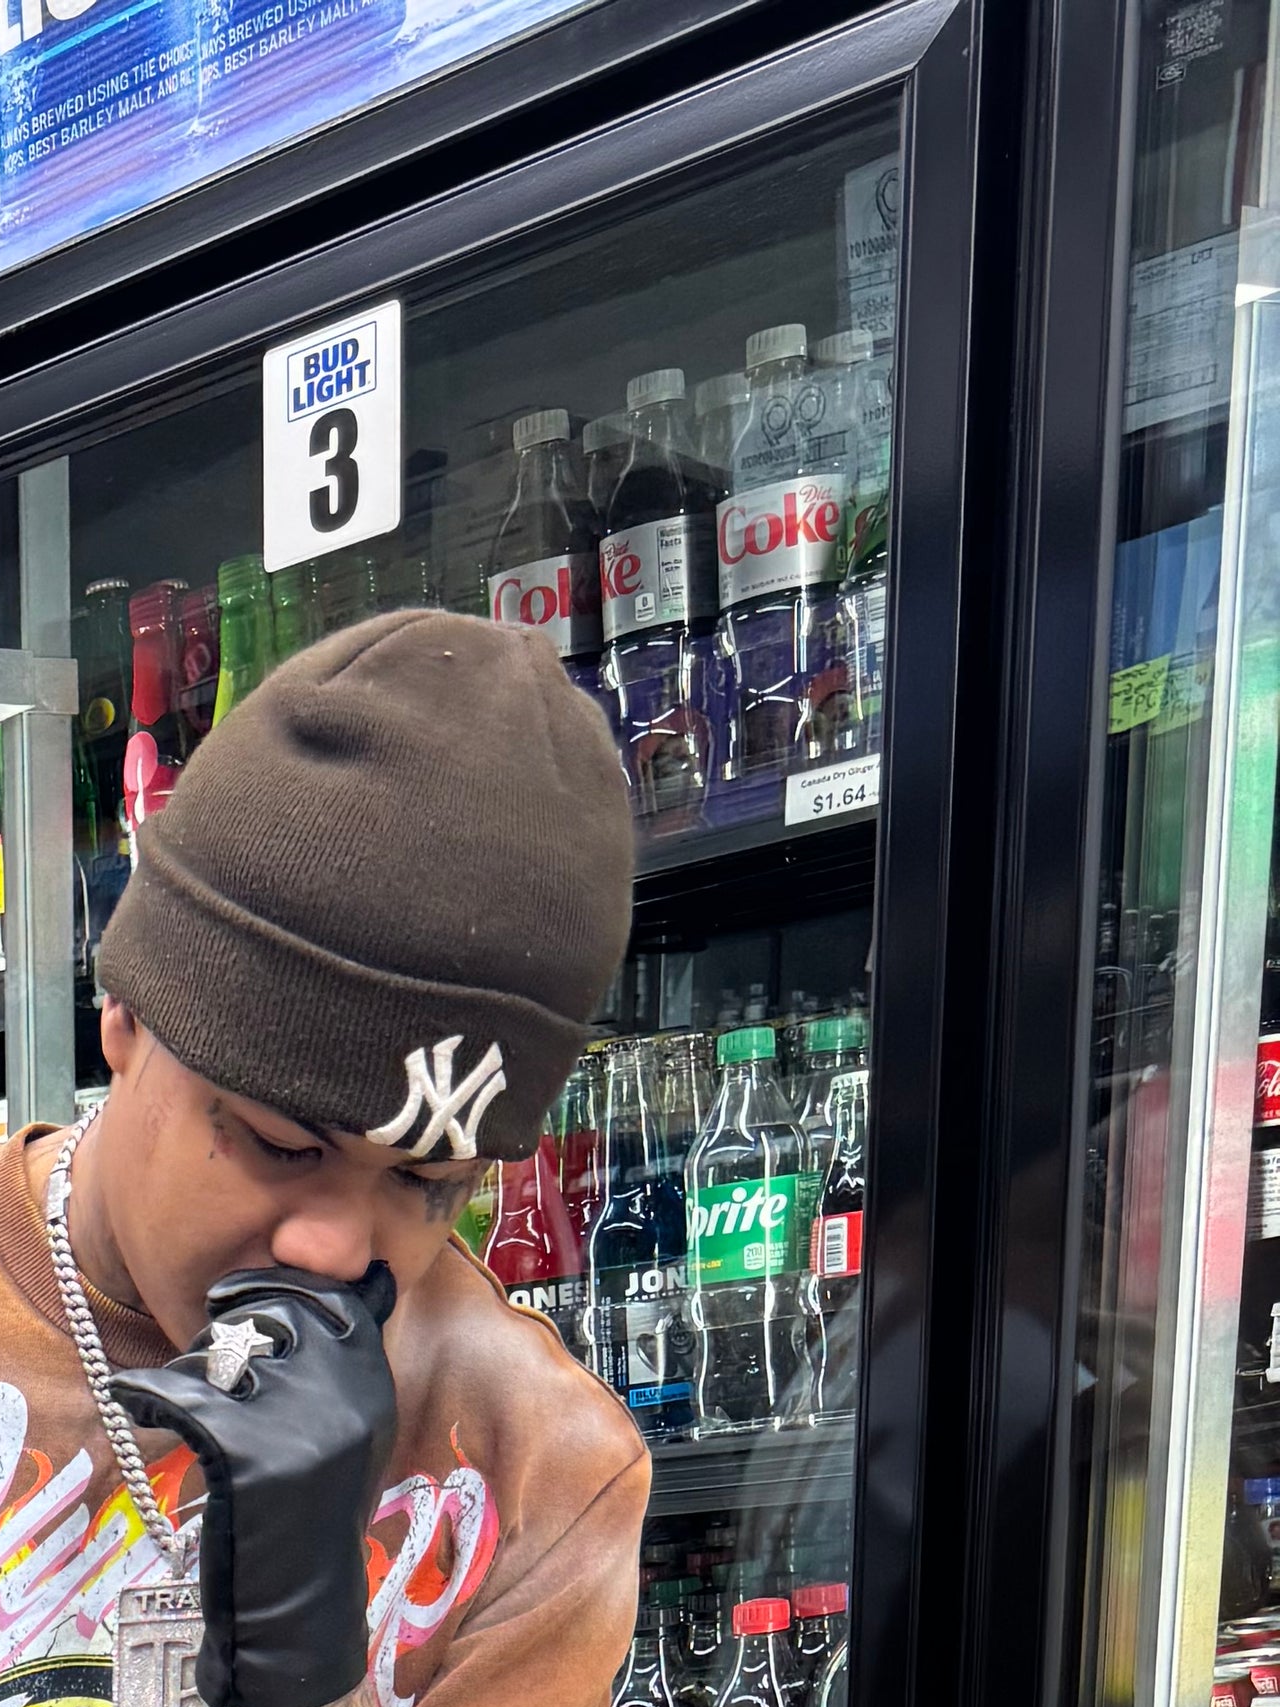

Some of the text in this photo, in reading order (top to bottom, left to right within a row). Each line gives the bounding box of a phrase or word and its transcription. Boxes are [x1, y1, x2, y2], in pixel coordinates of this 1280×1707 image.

[259, 20, 316, 56] BARLEY
[32, 63, 156, 129] BREWED USING THE
[27, 107, 114, 161] BEST BARLEY
[292, 359, 370, 414] LIGHT
[303, 337, 359, 382] BUD
[309, 408, 359, 534] 3
[799, 484, 833, 503] Diet
[719, 492, 839, 566] Coke
[812, 784, 867, 814] $1.64
[832, 771, 846, 780] Dry
[365, 1034, 507, 1160] NY
